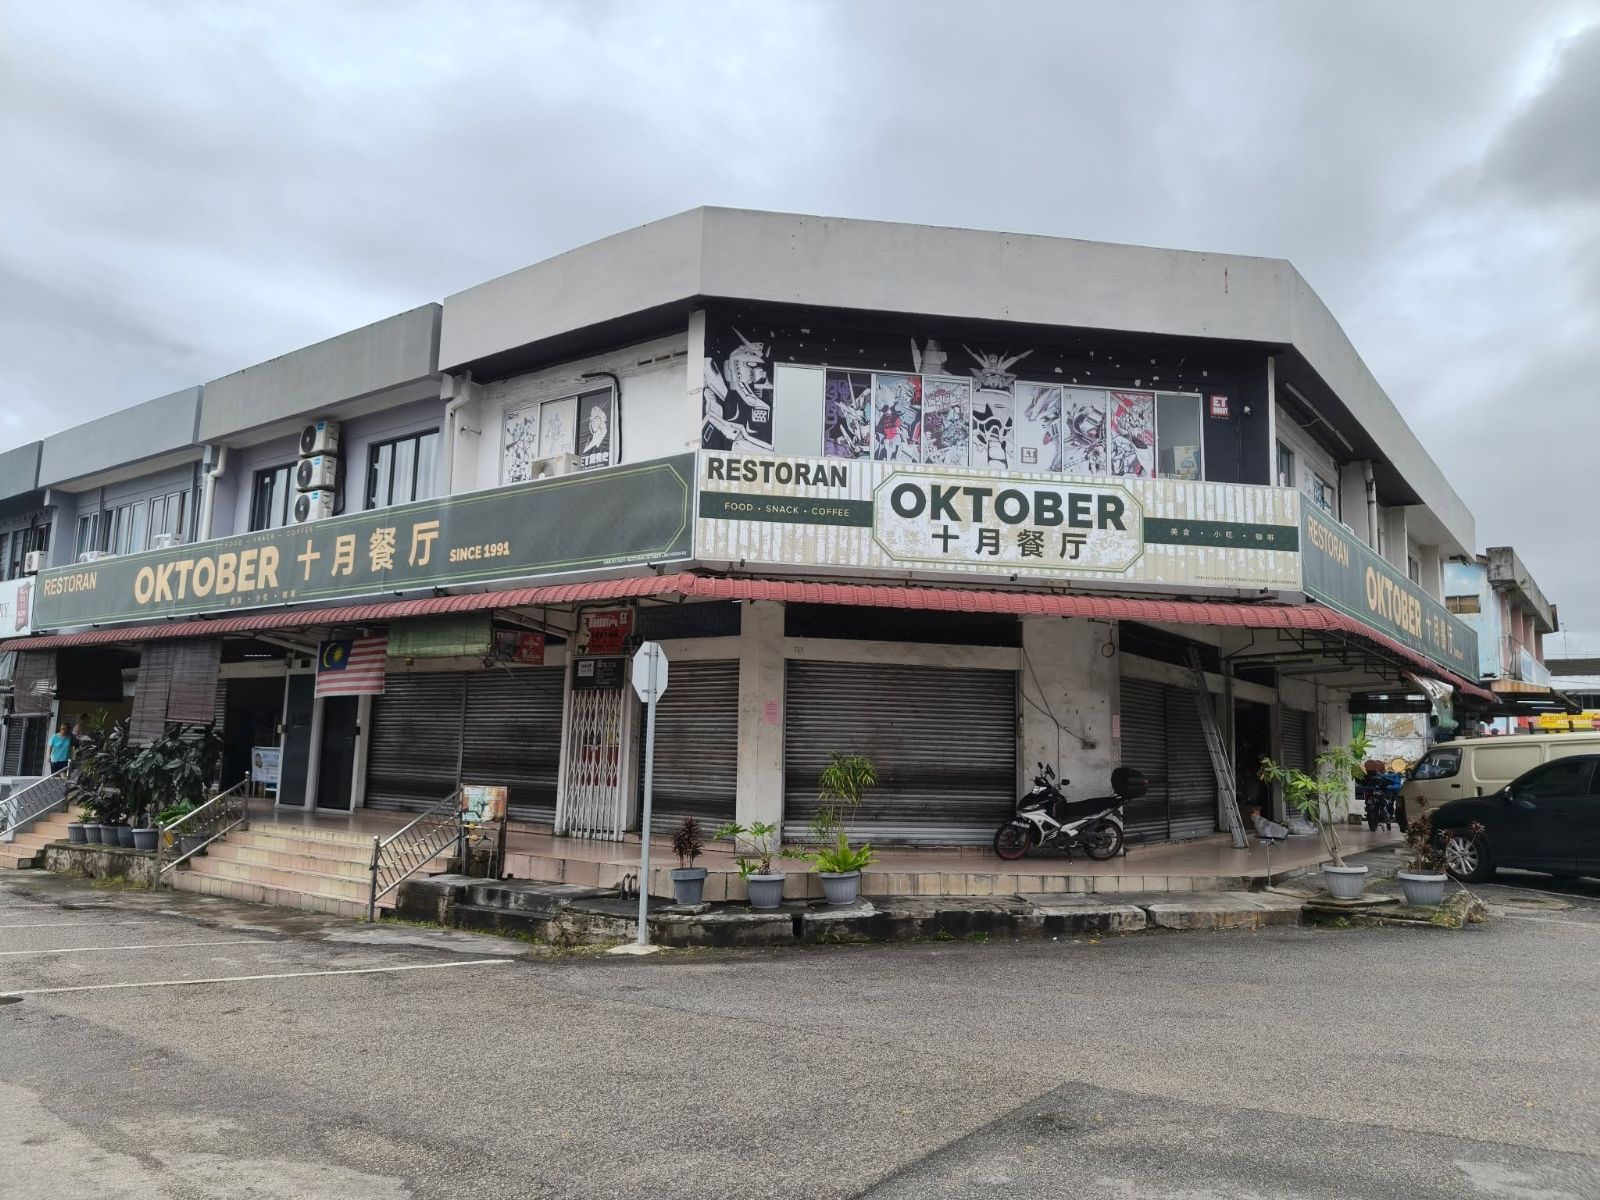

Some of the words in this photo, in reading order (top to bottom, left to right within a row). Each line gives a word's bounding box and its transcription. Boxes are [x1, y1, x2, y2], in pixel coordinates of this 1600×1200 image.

[707, 457, 847, 488] RESTORAN
[724, 502, 753, 511] FOOD
[765, 505, 799, 514] SNACK
[811, 507, 850, 517] COFFEE
[890, 482, 1126, 530] OKTOBER
[297, 520, 440, 581] 十月餐厅
[449, 545, 482, 563] SINCE
[483, 541, 510, 559] 1991
[931, 524, 1087, 559] 十月餐厅
[1307, 515, 1349, 568] RESTORAN
[43, 571, 97, 597] RESTORAN
[134, 545, 280, 604] OKTOBER
[1366, 566, 1422, 640] OKTOBER
